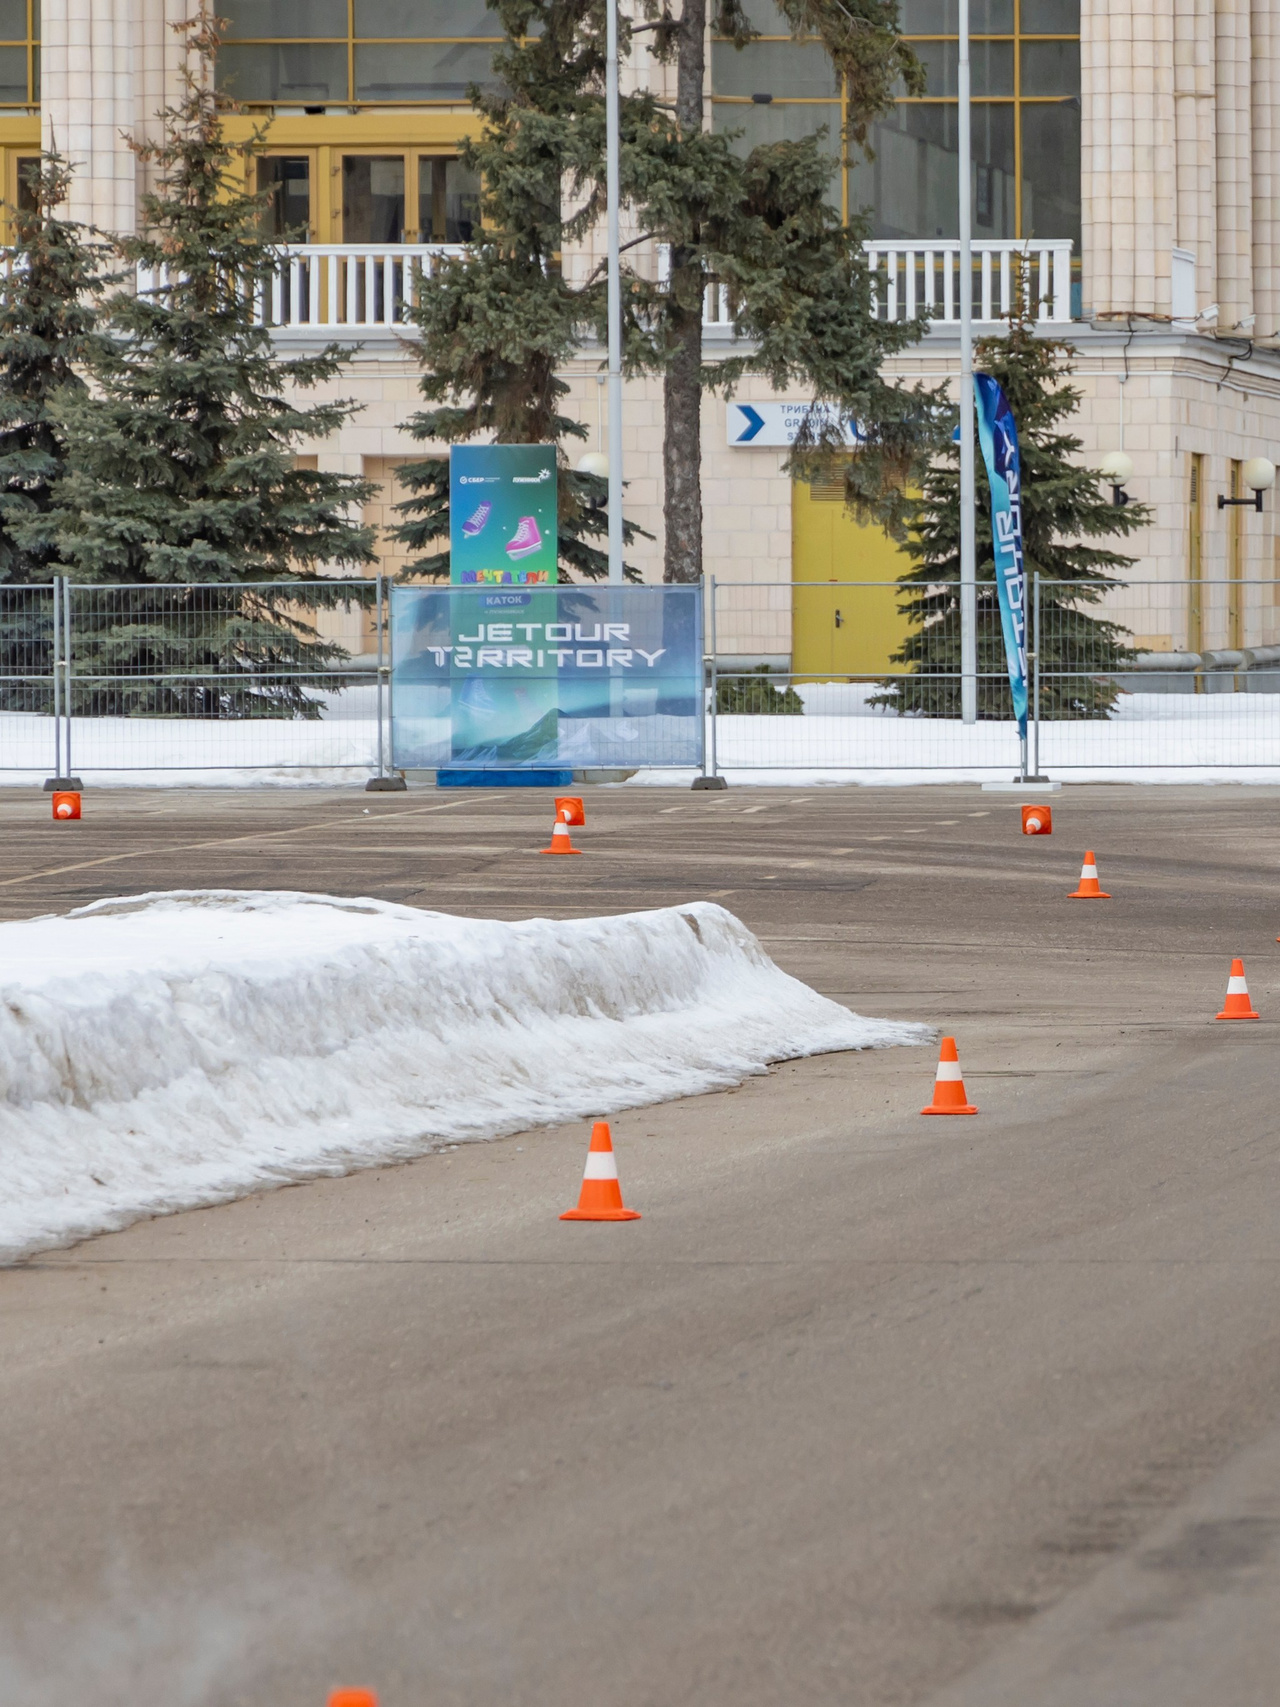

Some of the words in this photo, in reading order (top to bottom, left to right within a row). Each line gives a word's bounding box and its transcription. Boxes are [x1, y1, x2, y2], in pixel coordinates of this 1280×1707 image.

[461, 568, 549, 585] МЕЧТАТЕЛИ
[485, 595, 523, 606] КАТОК
[996, 511, 1028, 688] ETOUR
[458, 623, 630, 642] JETOUR
